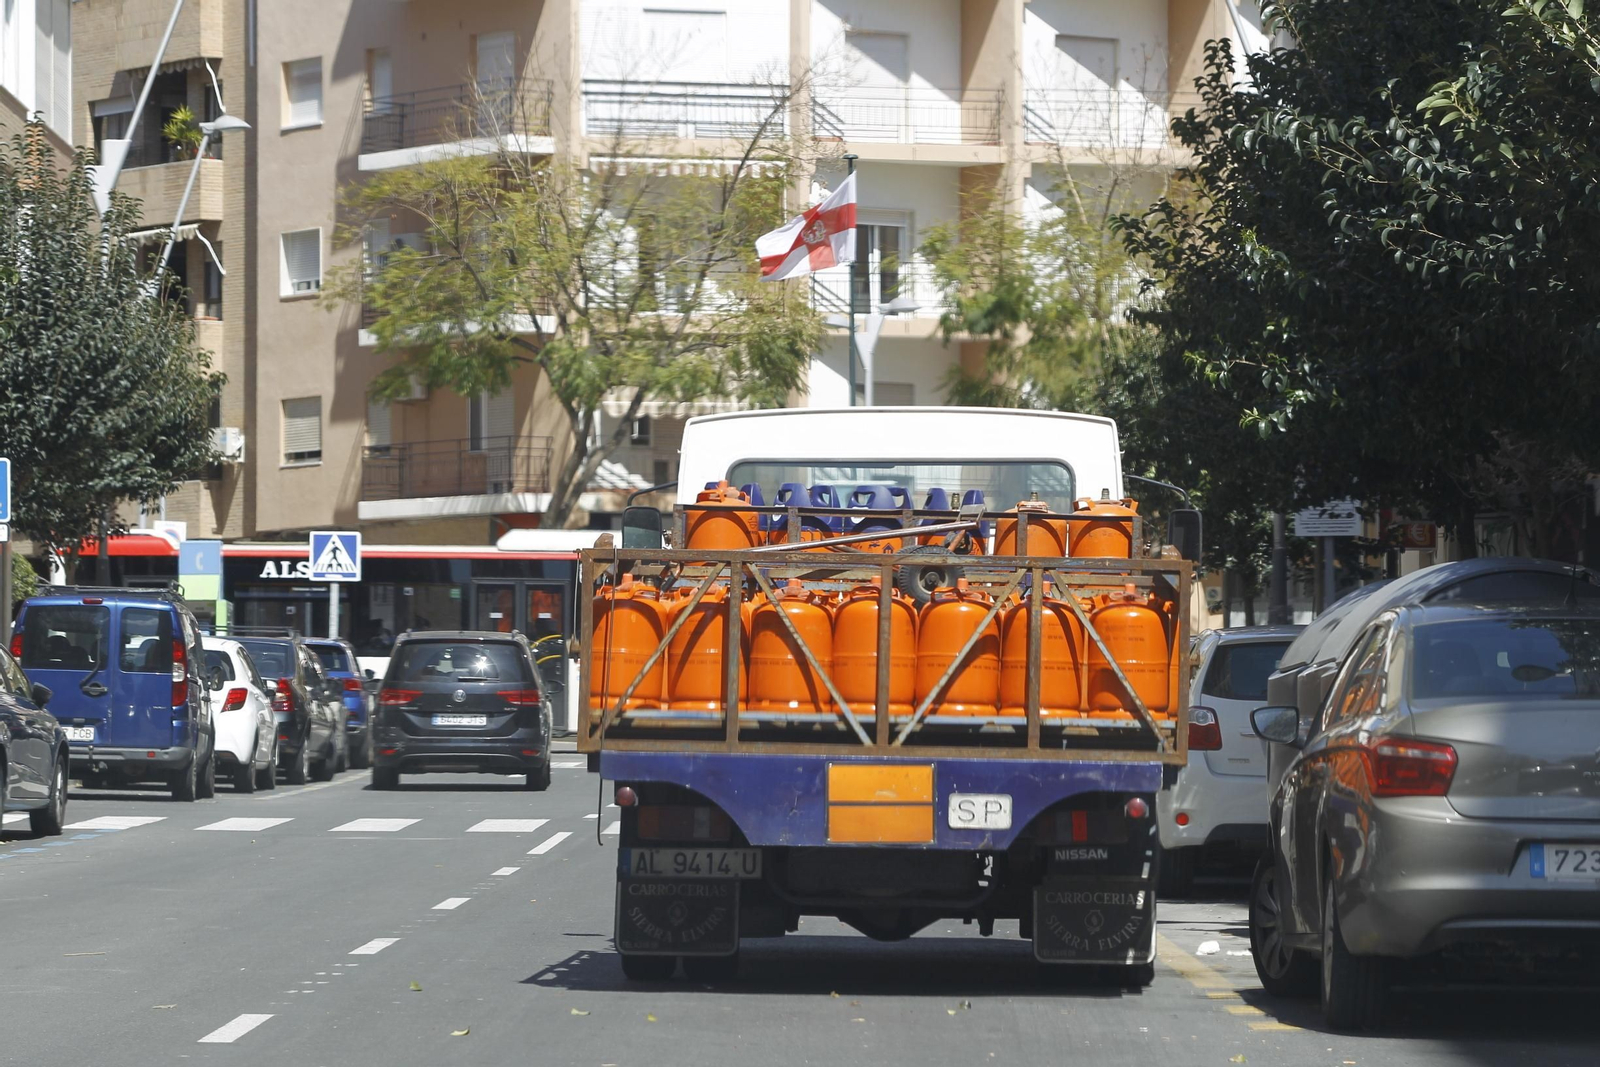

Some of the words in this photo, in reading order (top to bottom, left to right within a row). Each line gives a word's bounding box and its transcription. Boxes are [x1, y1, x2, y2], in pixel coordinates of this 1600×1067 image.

[73, 728, 92, 738] FCB
[1055, 848, 1108, 860] NISSAN
[635, 852, 663, 874] AL
[673, 852, 731, 874] 9414
[742, 852, 757, 874] U
[628, 883, 728, 897] CARROCERIAS
[1045, 891, 1145, 905] CARROCERIAS
[628, 906, 673, 943] SIERRA
[681, 906, 728, 943] ELVIRA
[1046, 914, 1090, 951] SIERRA
[1098, 915, 1143, 951] ELVIRA
